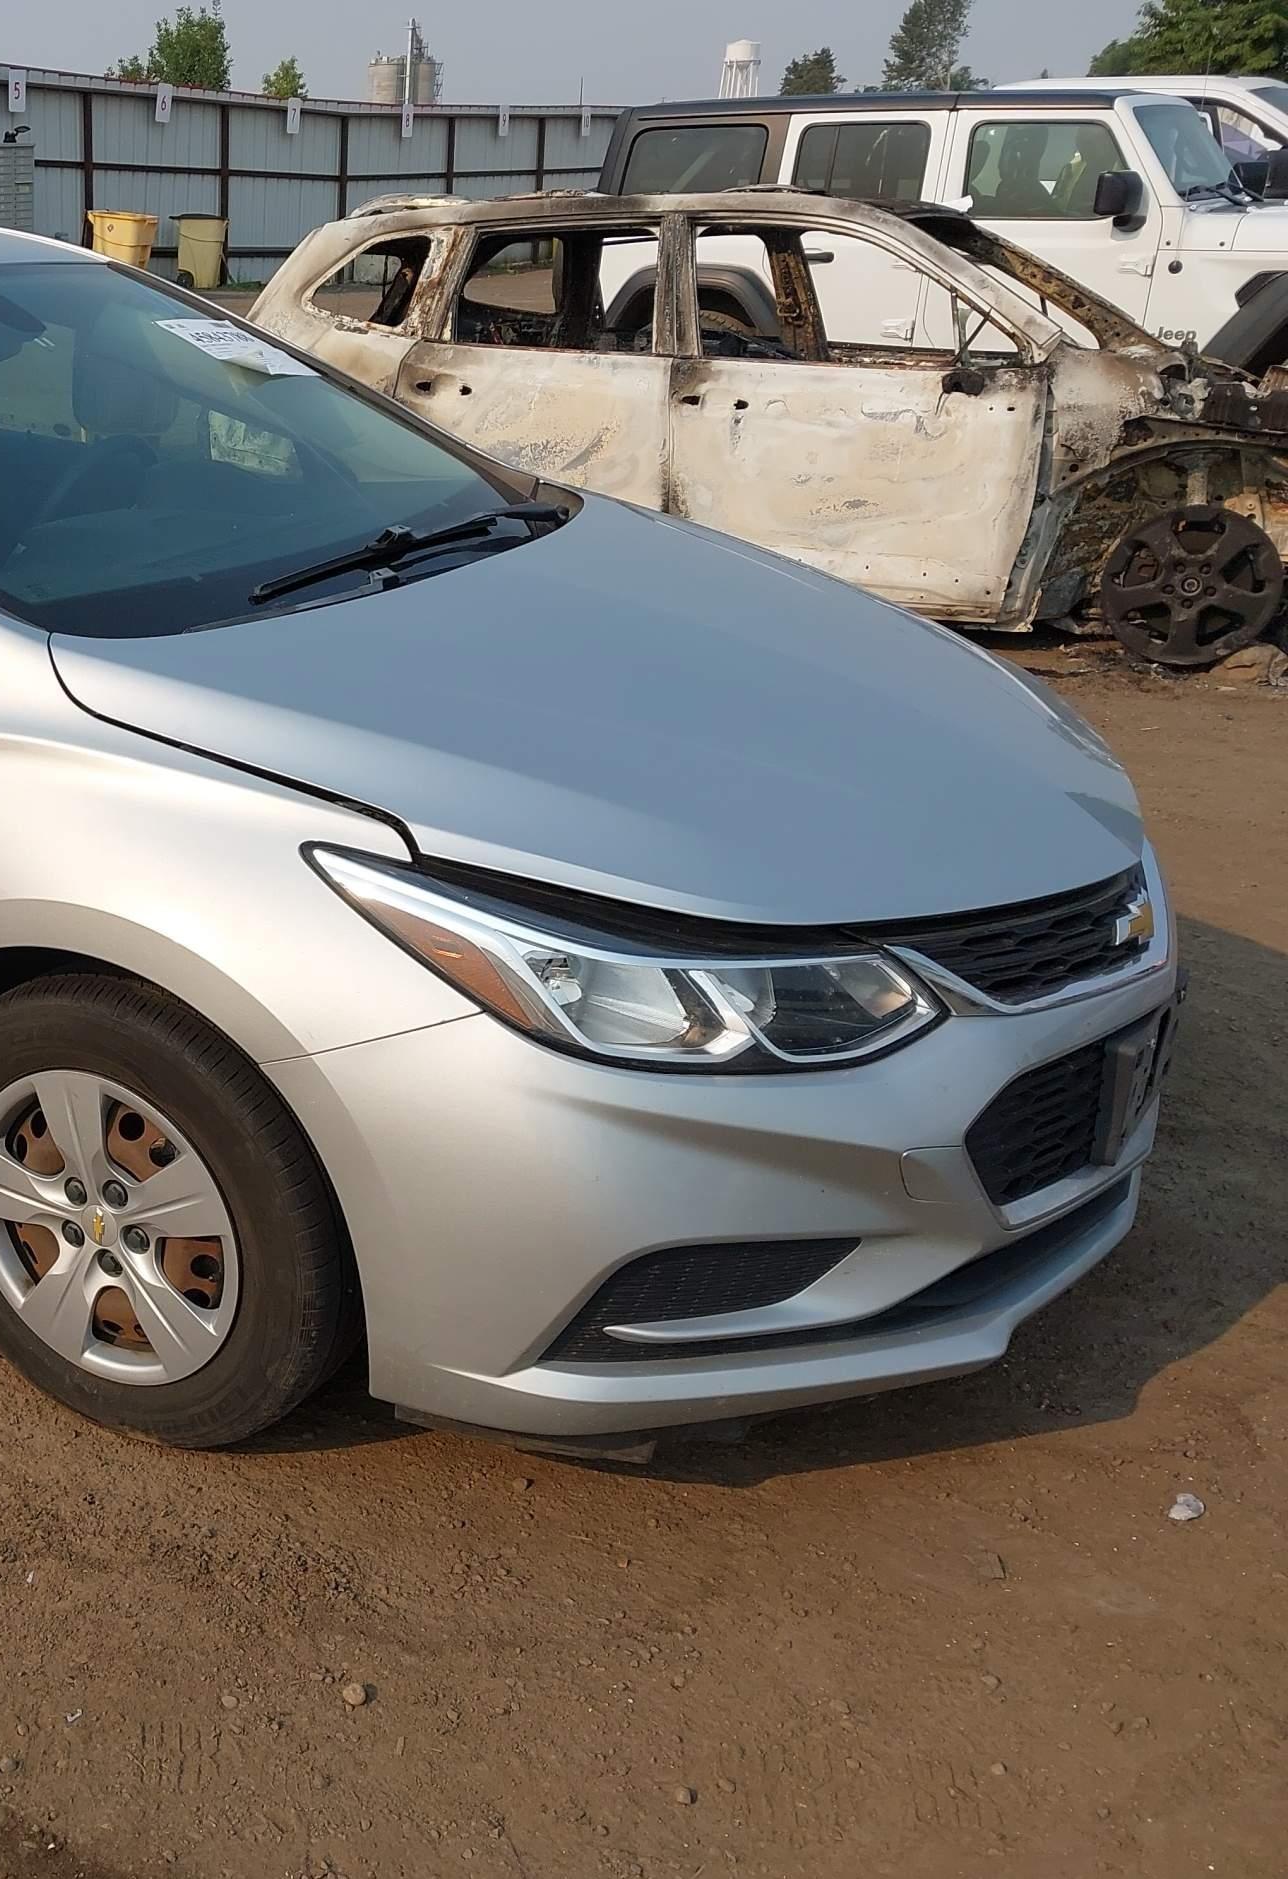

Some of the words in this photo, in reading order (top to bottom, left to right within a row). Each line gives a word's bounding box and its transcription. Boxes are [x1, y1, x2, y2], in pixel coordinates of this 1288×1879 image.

[14, 81, 21, 100] 5
[161, 95, 167, 111] 6
[291, 108, 297, 121] 7
[405, 113, 410, 128] 8
[502, 113, 507, 127] 9
[583, 115, 590, 128] 10
[1155, 326, 1197, 341] Jeep
